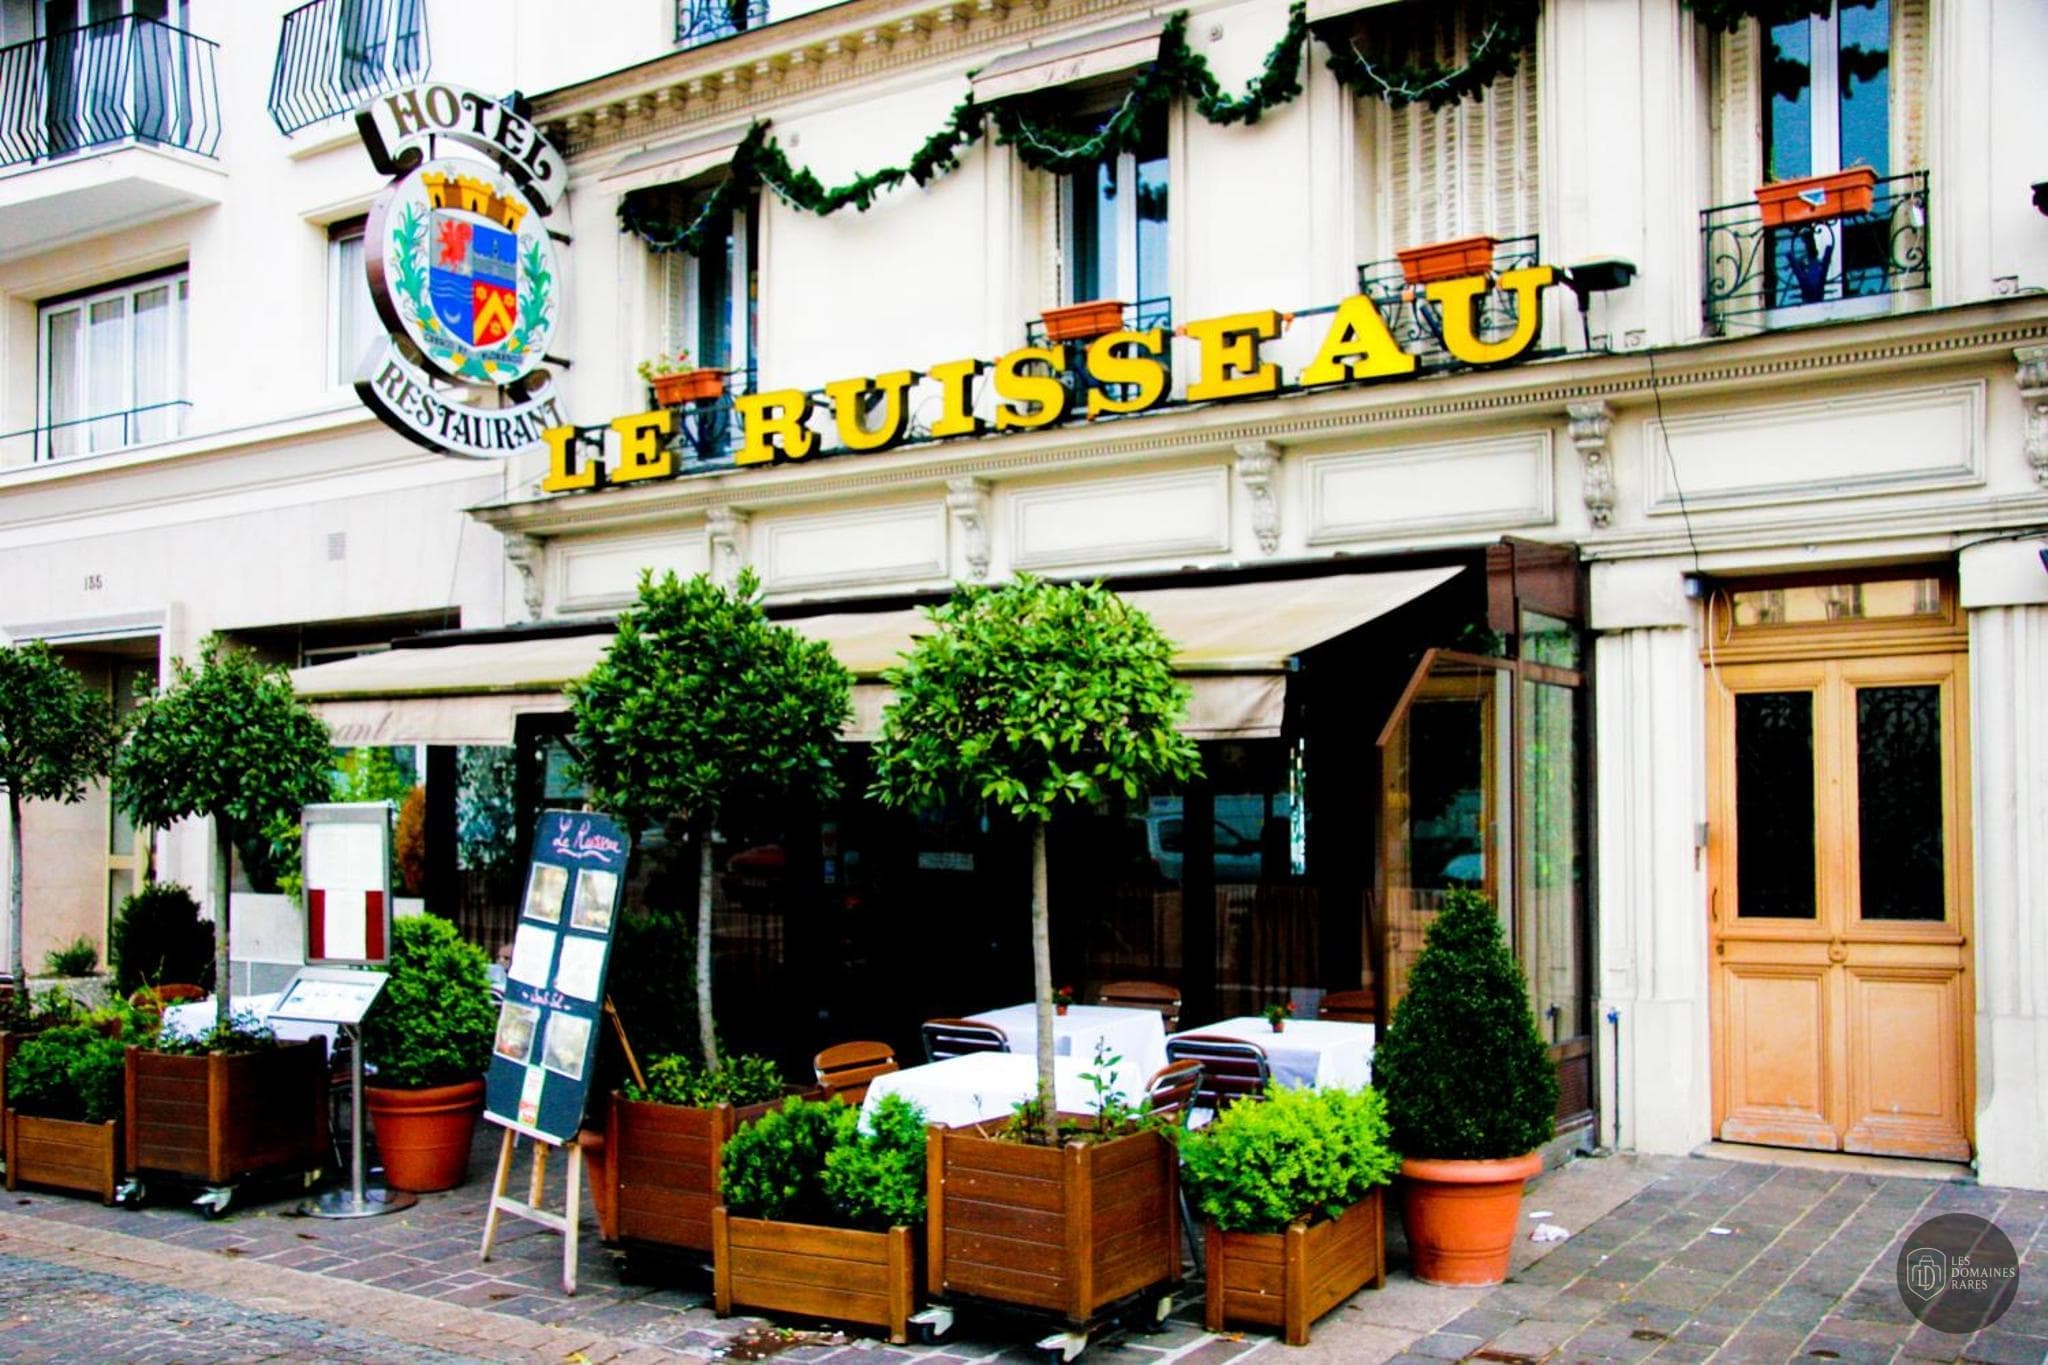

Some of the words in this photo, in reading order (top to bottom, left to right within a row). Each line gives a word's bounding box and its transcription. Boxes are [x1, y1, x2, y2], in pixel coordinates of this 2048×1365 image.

[383, 86, 552, 181] HOTEL
[375, 360, 562, 450] RESTAURANT
[543, 409, 674, 491] LE
[735, 266, 1554, 465] RUISSEAU
